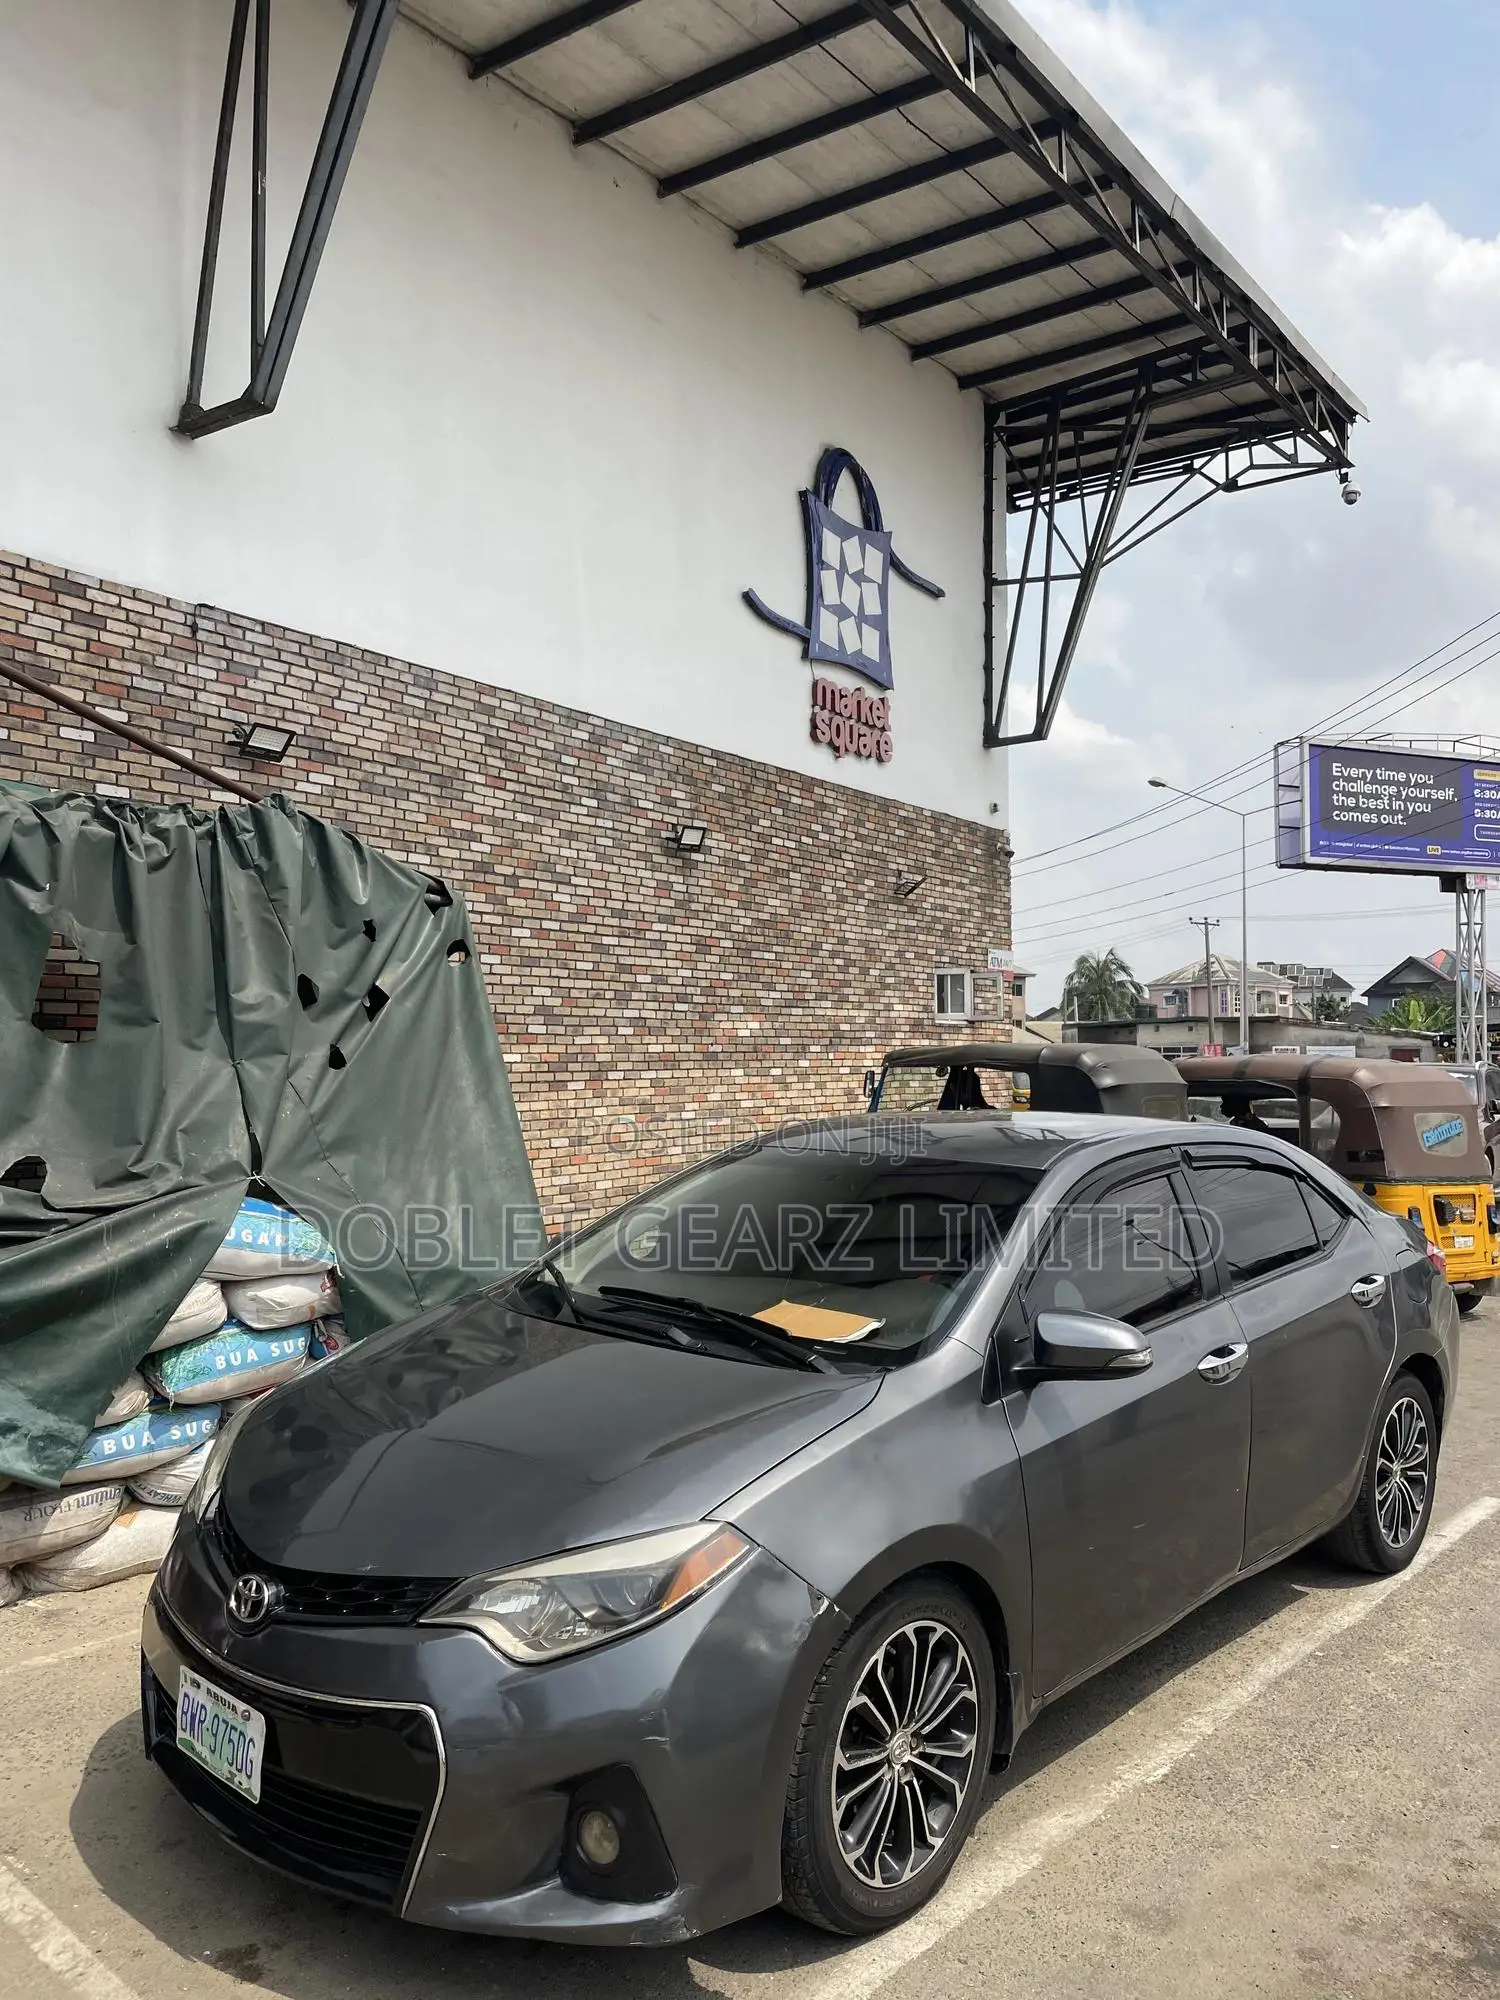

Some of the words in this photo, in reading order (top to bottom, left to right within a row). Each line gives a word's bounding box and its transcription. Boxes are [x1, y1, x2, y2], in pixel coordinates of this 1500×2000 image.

[813, 678, 892, 732] market
[811, 709, 894, 763] square
[1332, 762, 1374, 781] Every
[1375, 767, 1407, 782] time
[1408, 772, 1434, 785] you
[1332, 780, 1398, 799] challenge
[1332, 793, 1356, 807] the
[1359, 796, 1390, 809] best
[1392, 797, 1405, 810] in
[1407, 801, 1432, 814] you
[1332, 810, 1378, 824] comes
[1380, 812, 1407, 825] out.
[225, 1227, 287, 1247] UGAR
[215, 1348, 259, 1369] BUA
[270, 1337, 306, 1357] SUG
[102, 1431, 156, 1455] BUA
[170, 1419, 218, 1440] SUG
[24, 1499, 71, 1522] FLOUR
